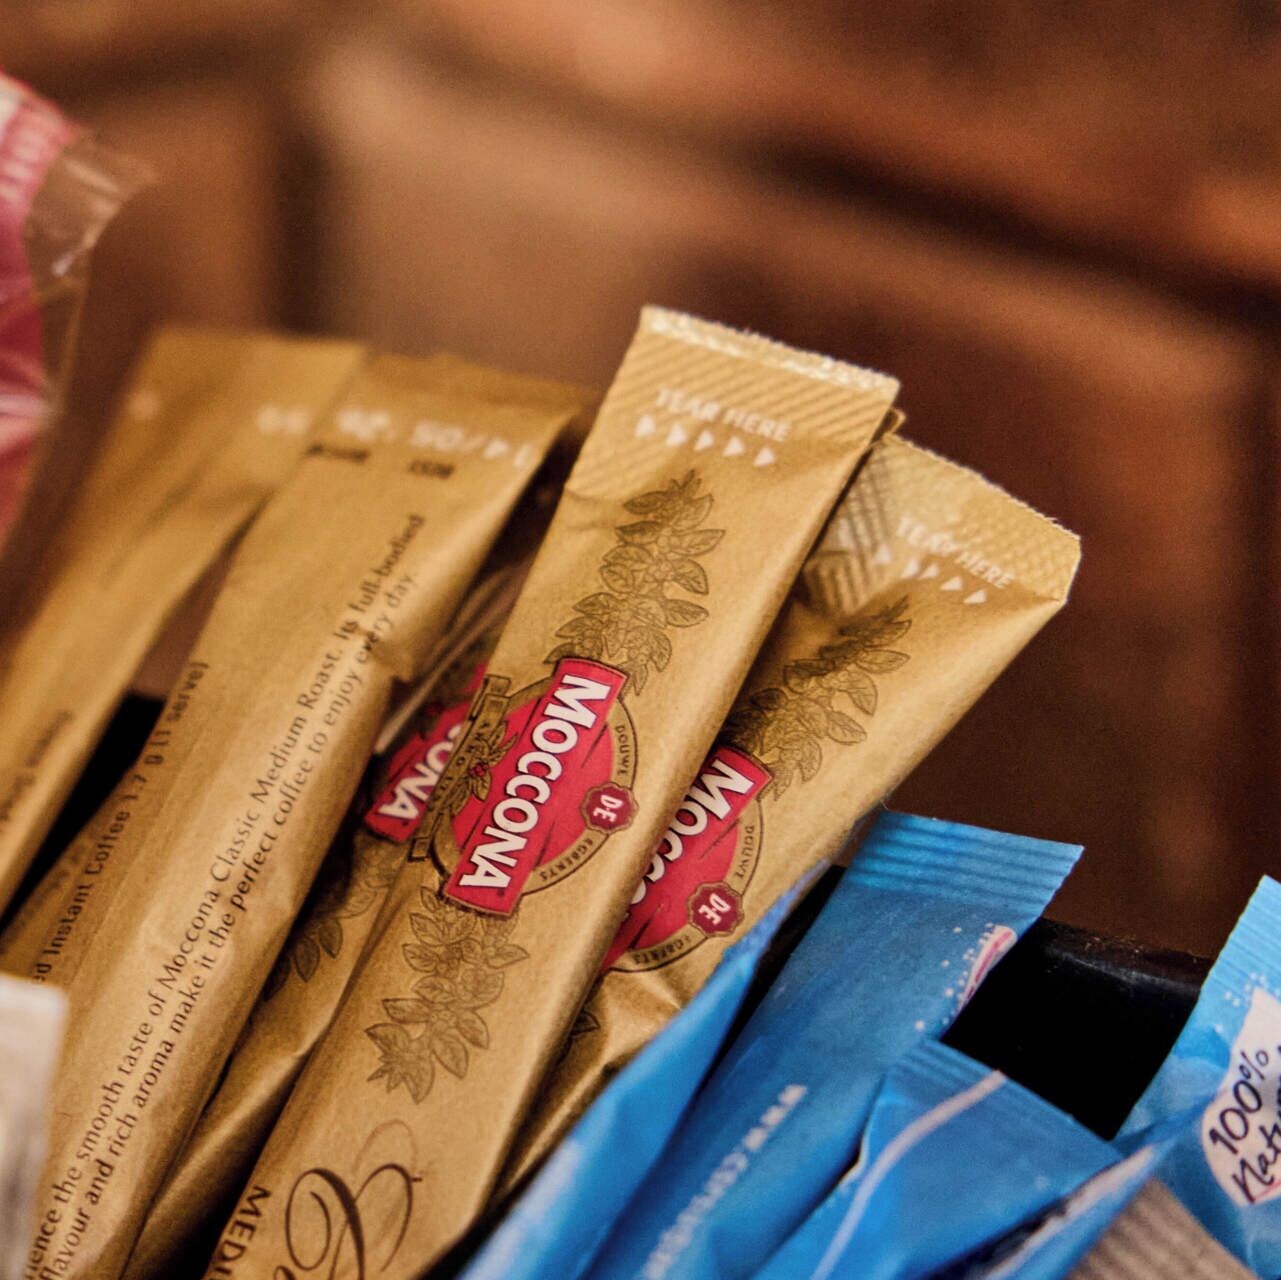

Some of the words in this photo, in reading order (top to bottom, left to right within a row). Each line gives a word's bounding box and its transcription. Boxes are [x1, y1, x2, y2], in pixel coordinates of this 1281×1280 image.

[459, 674, 611, 888] MOCCONA
[614, 724, 631, 775] DOUWE
[41, 883, 93, 957] Instant
[85, 810, 130, 875] Coffee
[122, 773, 147, 801] 1.7
[143, 753, 165, 766] g
[52, 1166, 82, 1204] the
[76, 1079, 125, 1160] smooth
[117, 1022, 154, 1076] taste
[147, 989, 167, 1017] of
[157, 888, 219, 990] Moccona
[210, 809, 260, 882] Classic
[250, 716, 307, 804] Medium
[296, 649, 343, 711] Roast.
[333, 619, 360, 640] Its
[347, 513, 426, 613] full-bodied
[85, 1158, 114, 1206] and
[109, 1113, 138, 1157] rich
[131, 1039, 176, 1110] aroma
[169, 974, 206, 1036] make
[194, 954, 216, 970] it
[208, 912, 236, 950] the
[230, 831, 279, 913] perfect
[273, 759, 313, 827] coffee
[308, 732, 328, 756] to
[324, 670, 363, 728] enjoy
[356, 614, 392, 665] every
[542, 838, 593, 881] EGBERTS
[1208, 1050, 1269, 1155] 100%
